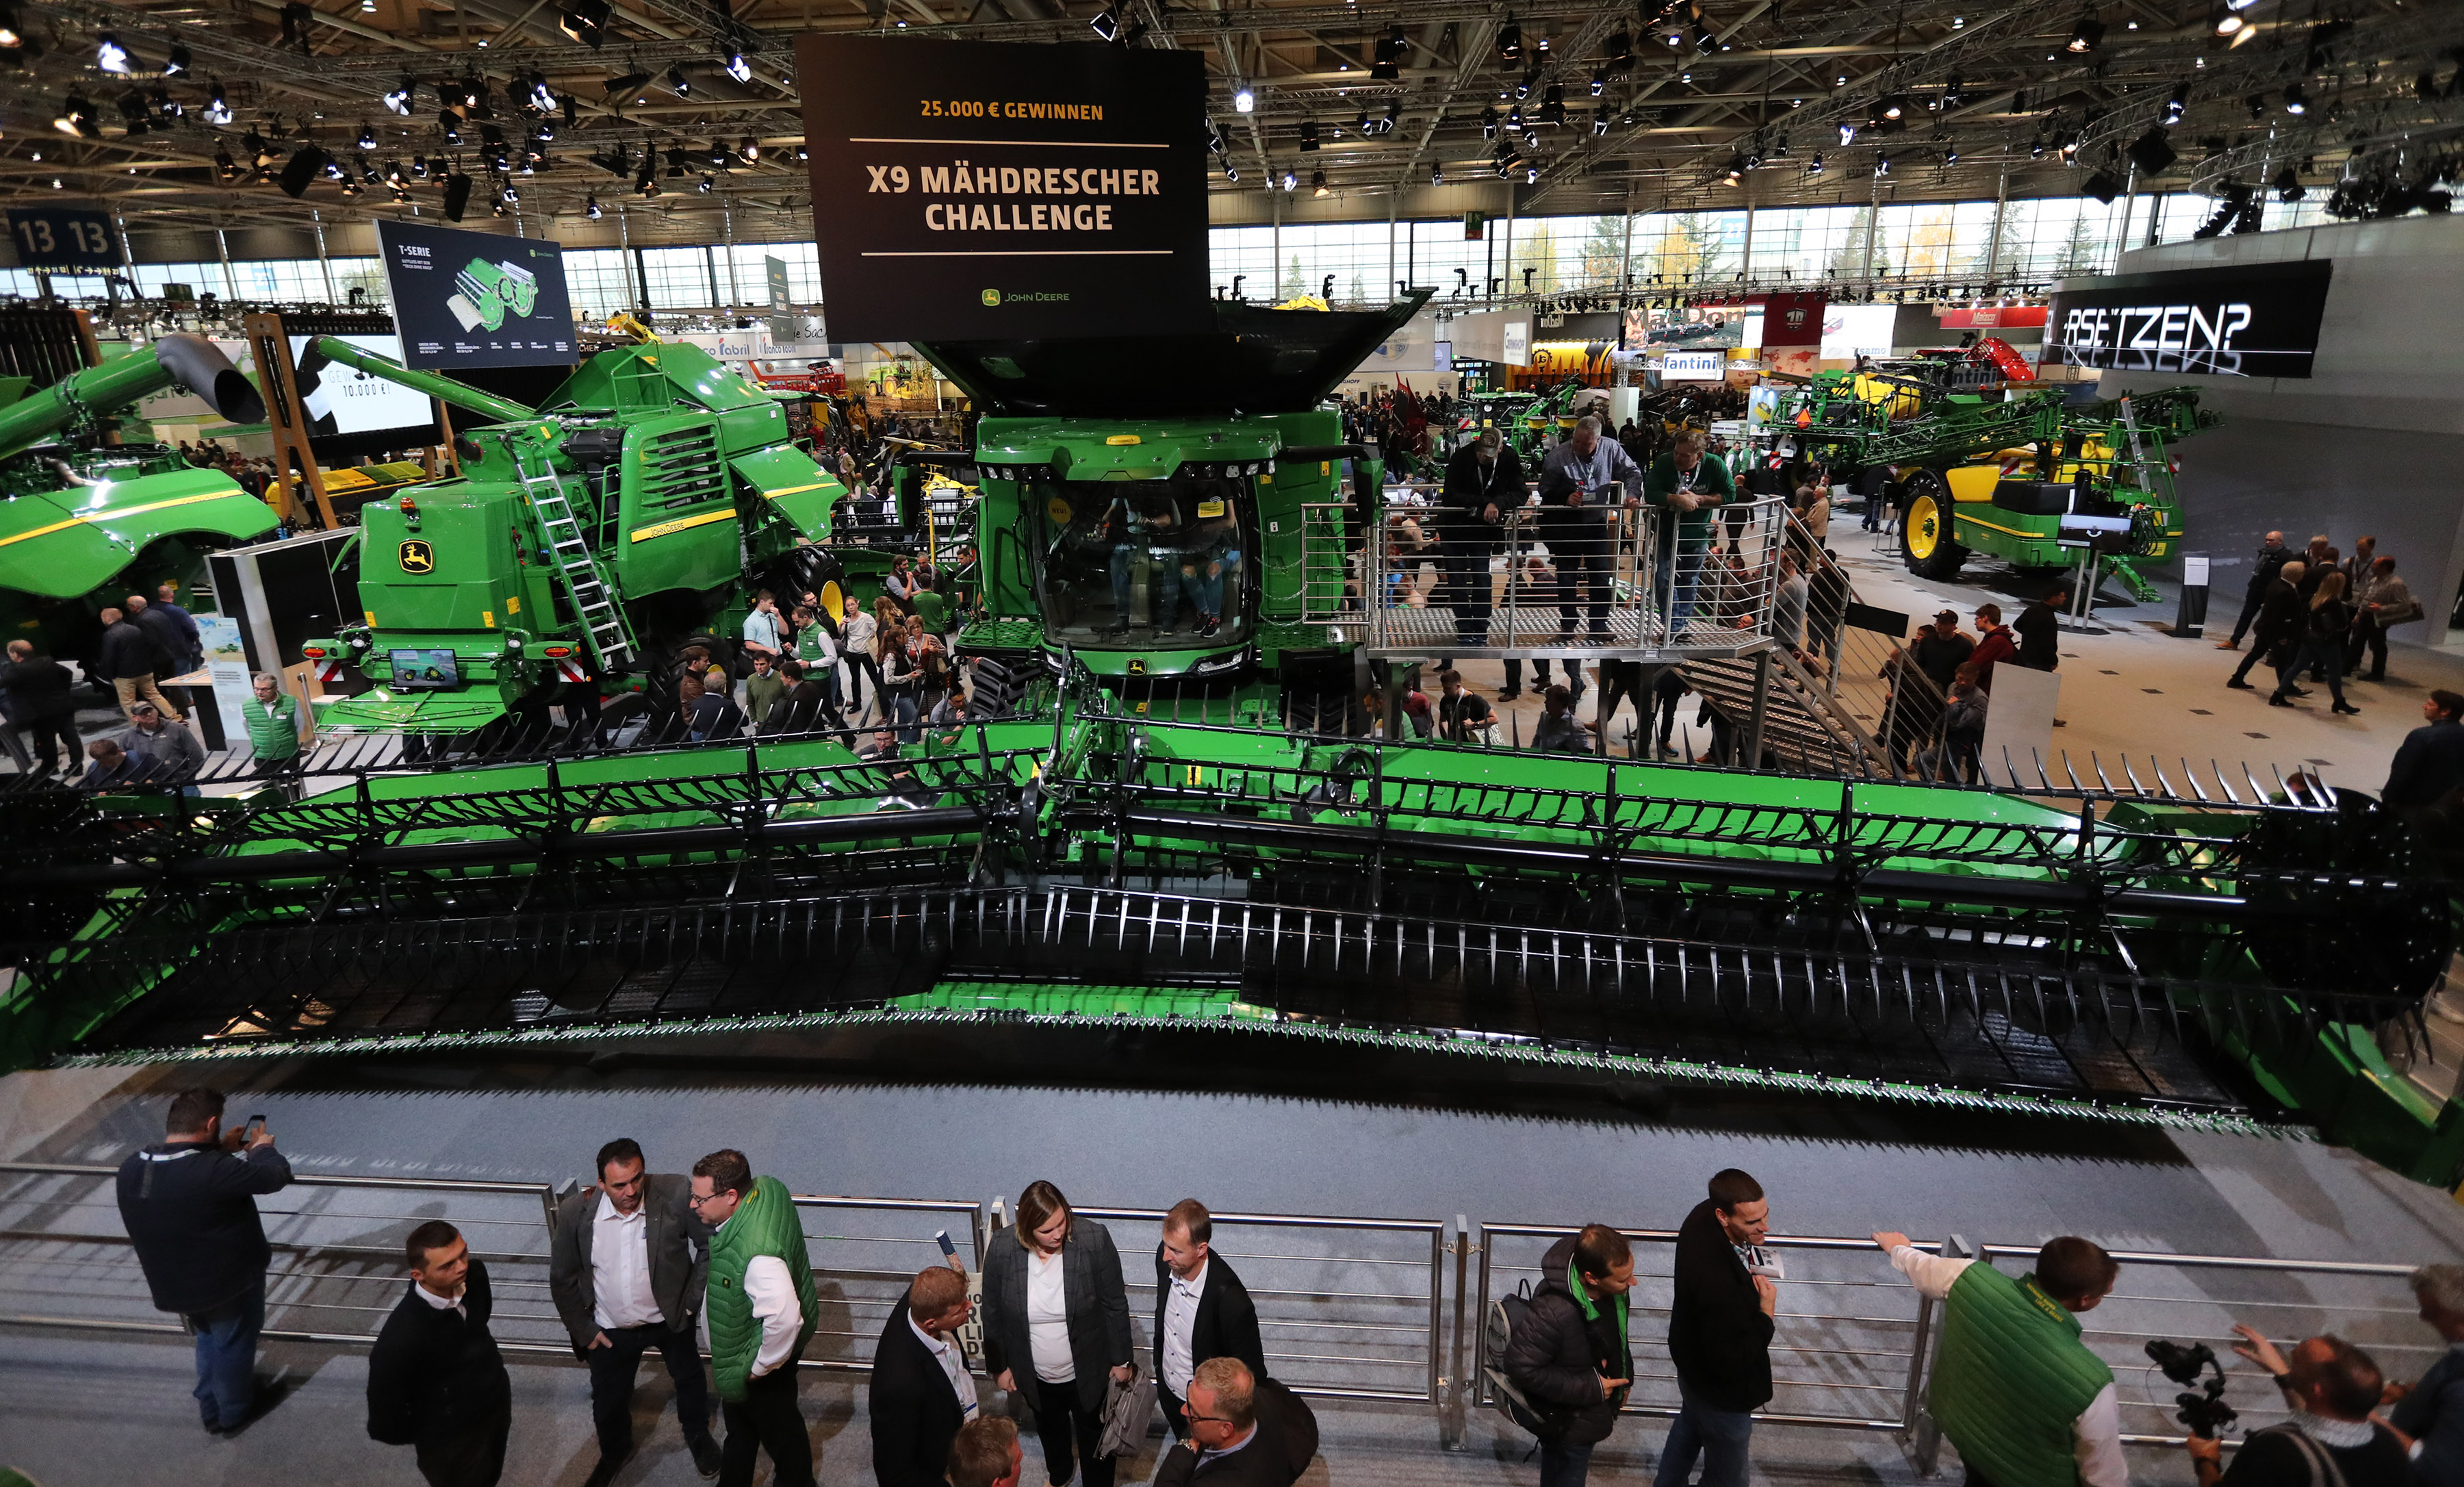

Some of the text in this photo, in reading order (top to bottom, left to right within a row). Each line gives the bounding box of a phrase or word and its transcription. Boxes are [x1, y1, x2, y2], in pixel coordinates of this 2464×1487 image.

[921, 100, 1103, 120] 25.000 € GEWINNEN
[866, 160, 1160, 195] X9 MÄHDRESCHER
[925, 203, 1113, 231] CHALLENGE
[18, 220, 108, 253] 13 13
[398, 244, 431, 257] T-SERIE
[1621, 307, 1745, 331] MacDon
[1970, 312, 1997, 325] Maizco
[2063, 304, 2253, 351] RSETZEN?
[1664, 356, 1717, 370] fantini
[344, 383, 376, 397] 10.000
[650, 522, 685, 539] JOHN DEERE
